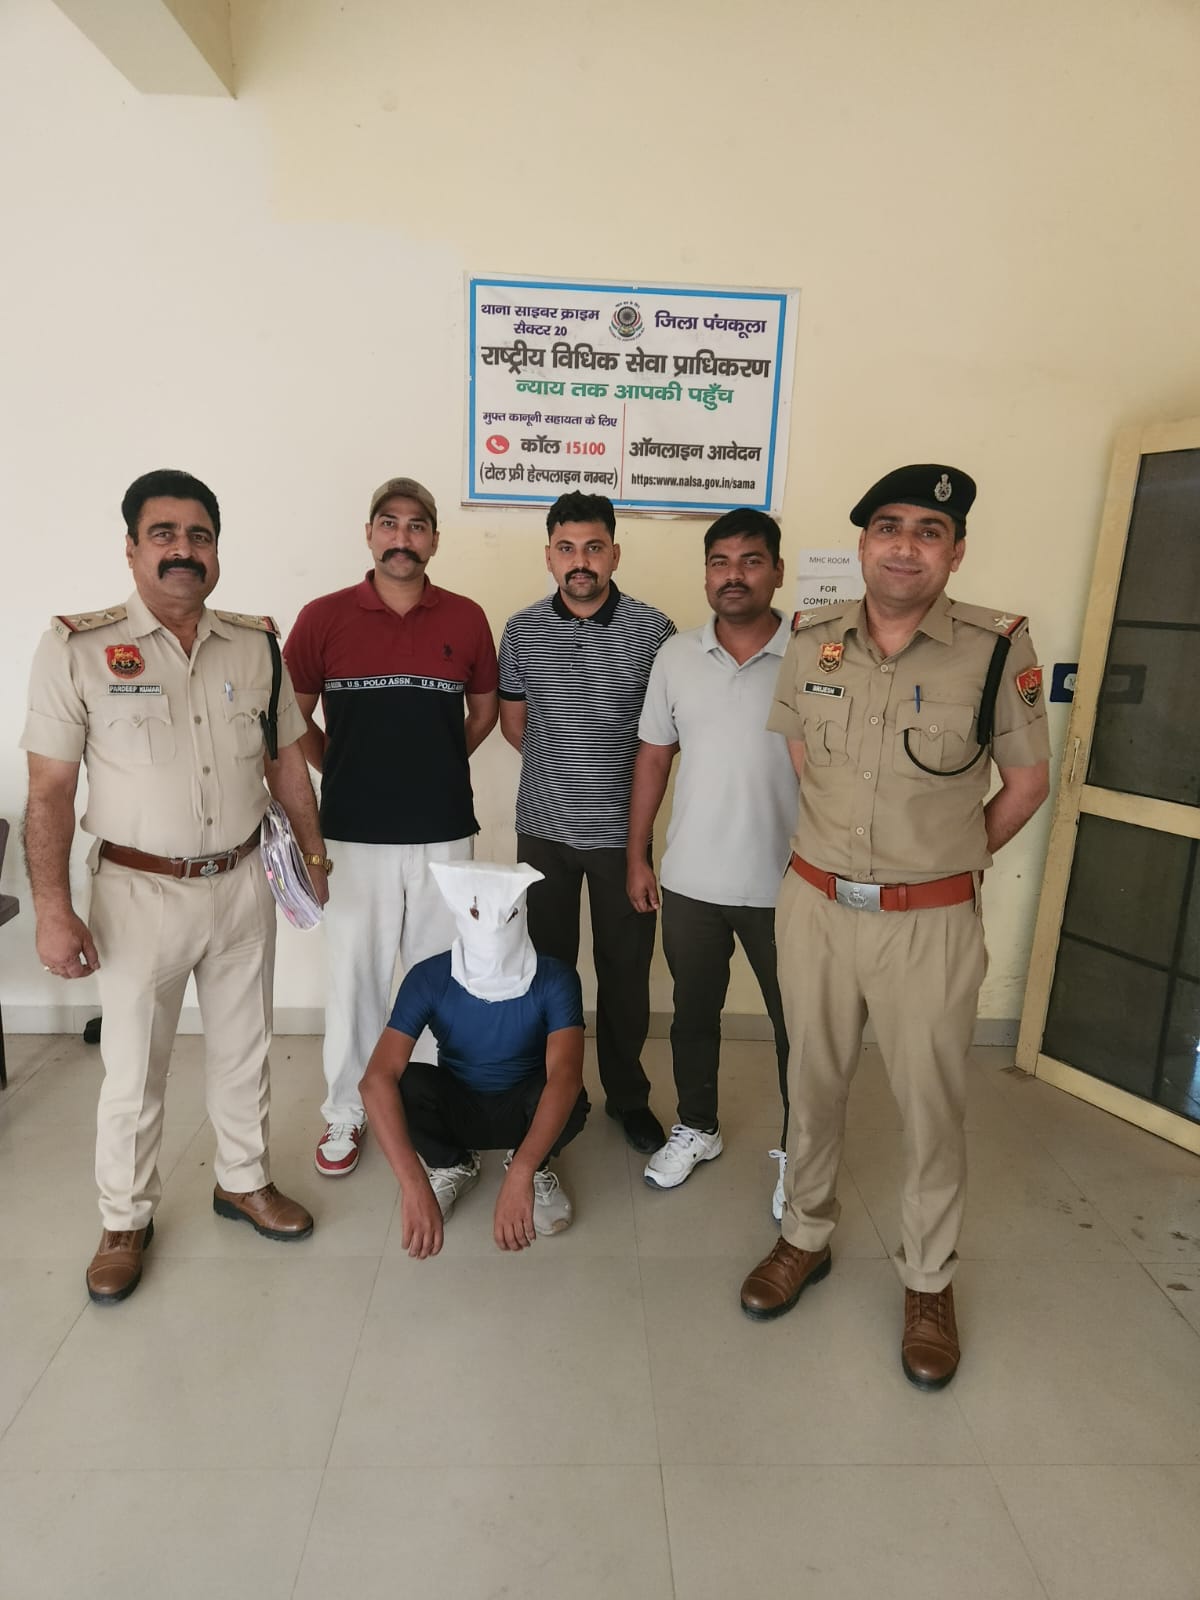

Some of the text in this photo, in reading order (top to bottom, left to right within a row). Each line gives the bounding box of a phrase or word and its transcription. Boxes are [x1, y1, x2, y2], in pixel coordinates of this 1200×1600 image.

[481, 304, 600, 321] थाना साइबर क्राइम
[554, 326, 567, 336] 20
[655, 310, 767, 338] जिला पंचकूला
[480, 339, 771, 378] राष्ट्रीय विधिक सेवा प्राधिकरण
[515, 379, 734, 411] न्याय तक आपकी पहुँच
[509, 411, 542, 426] कानूनी
[544, 414, 582, 425] सहायता
[585, 414, 596, 425] के
[598, 414, 617, 427] लिए
[520, 434, 606, 456] कॉल 15100
[629, 437, 762, 462] ऑनलाइन आवेदन
[508, 463, 525, 482] फ्री
[527, 464, 581, 485] हेल्पलाइन
[631, 473, 756, 490] https:www.nalsa.gov.in/sama
[820, 585, 837, 593] FOR
[363, 678, 387, 687] POLO
